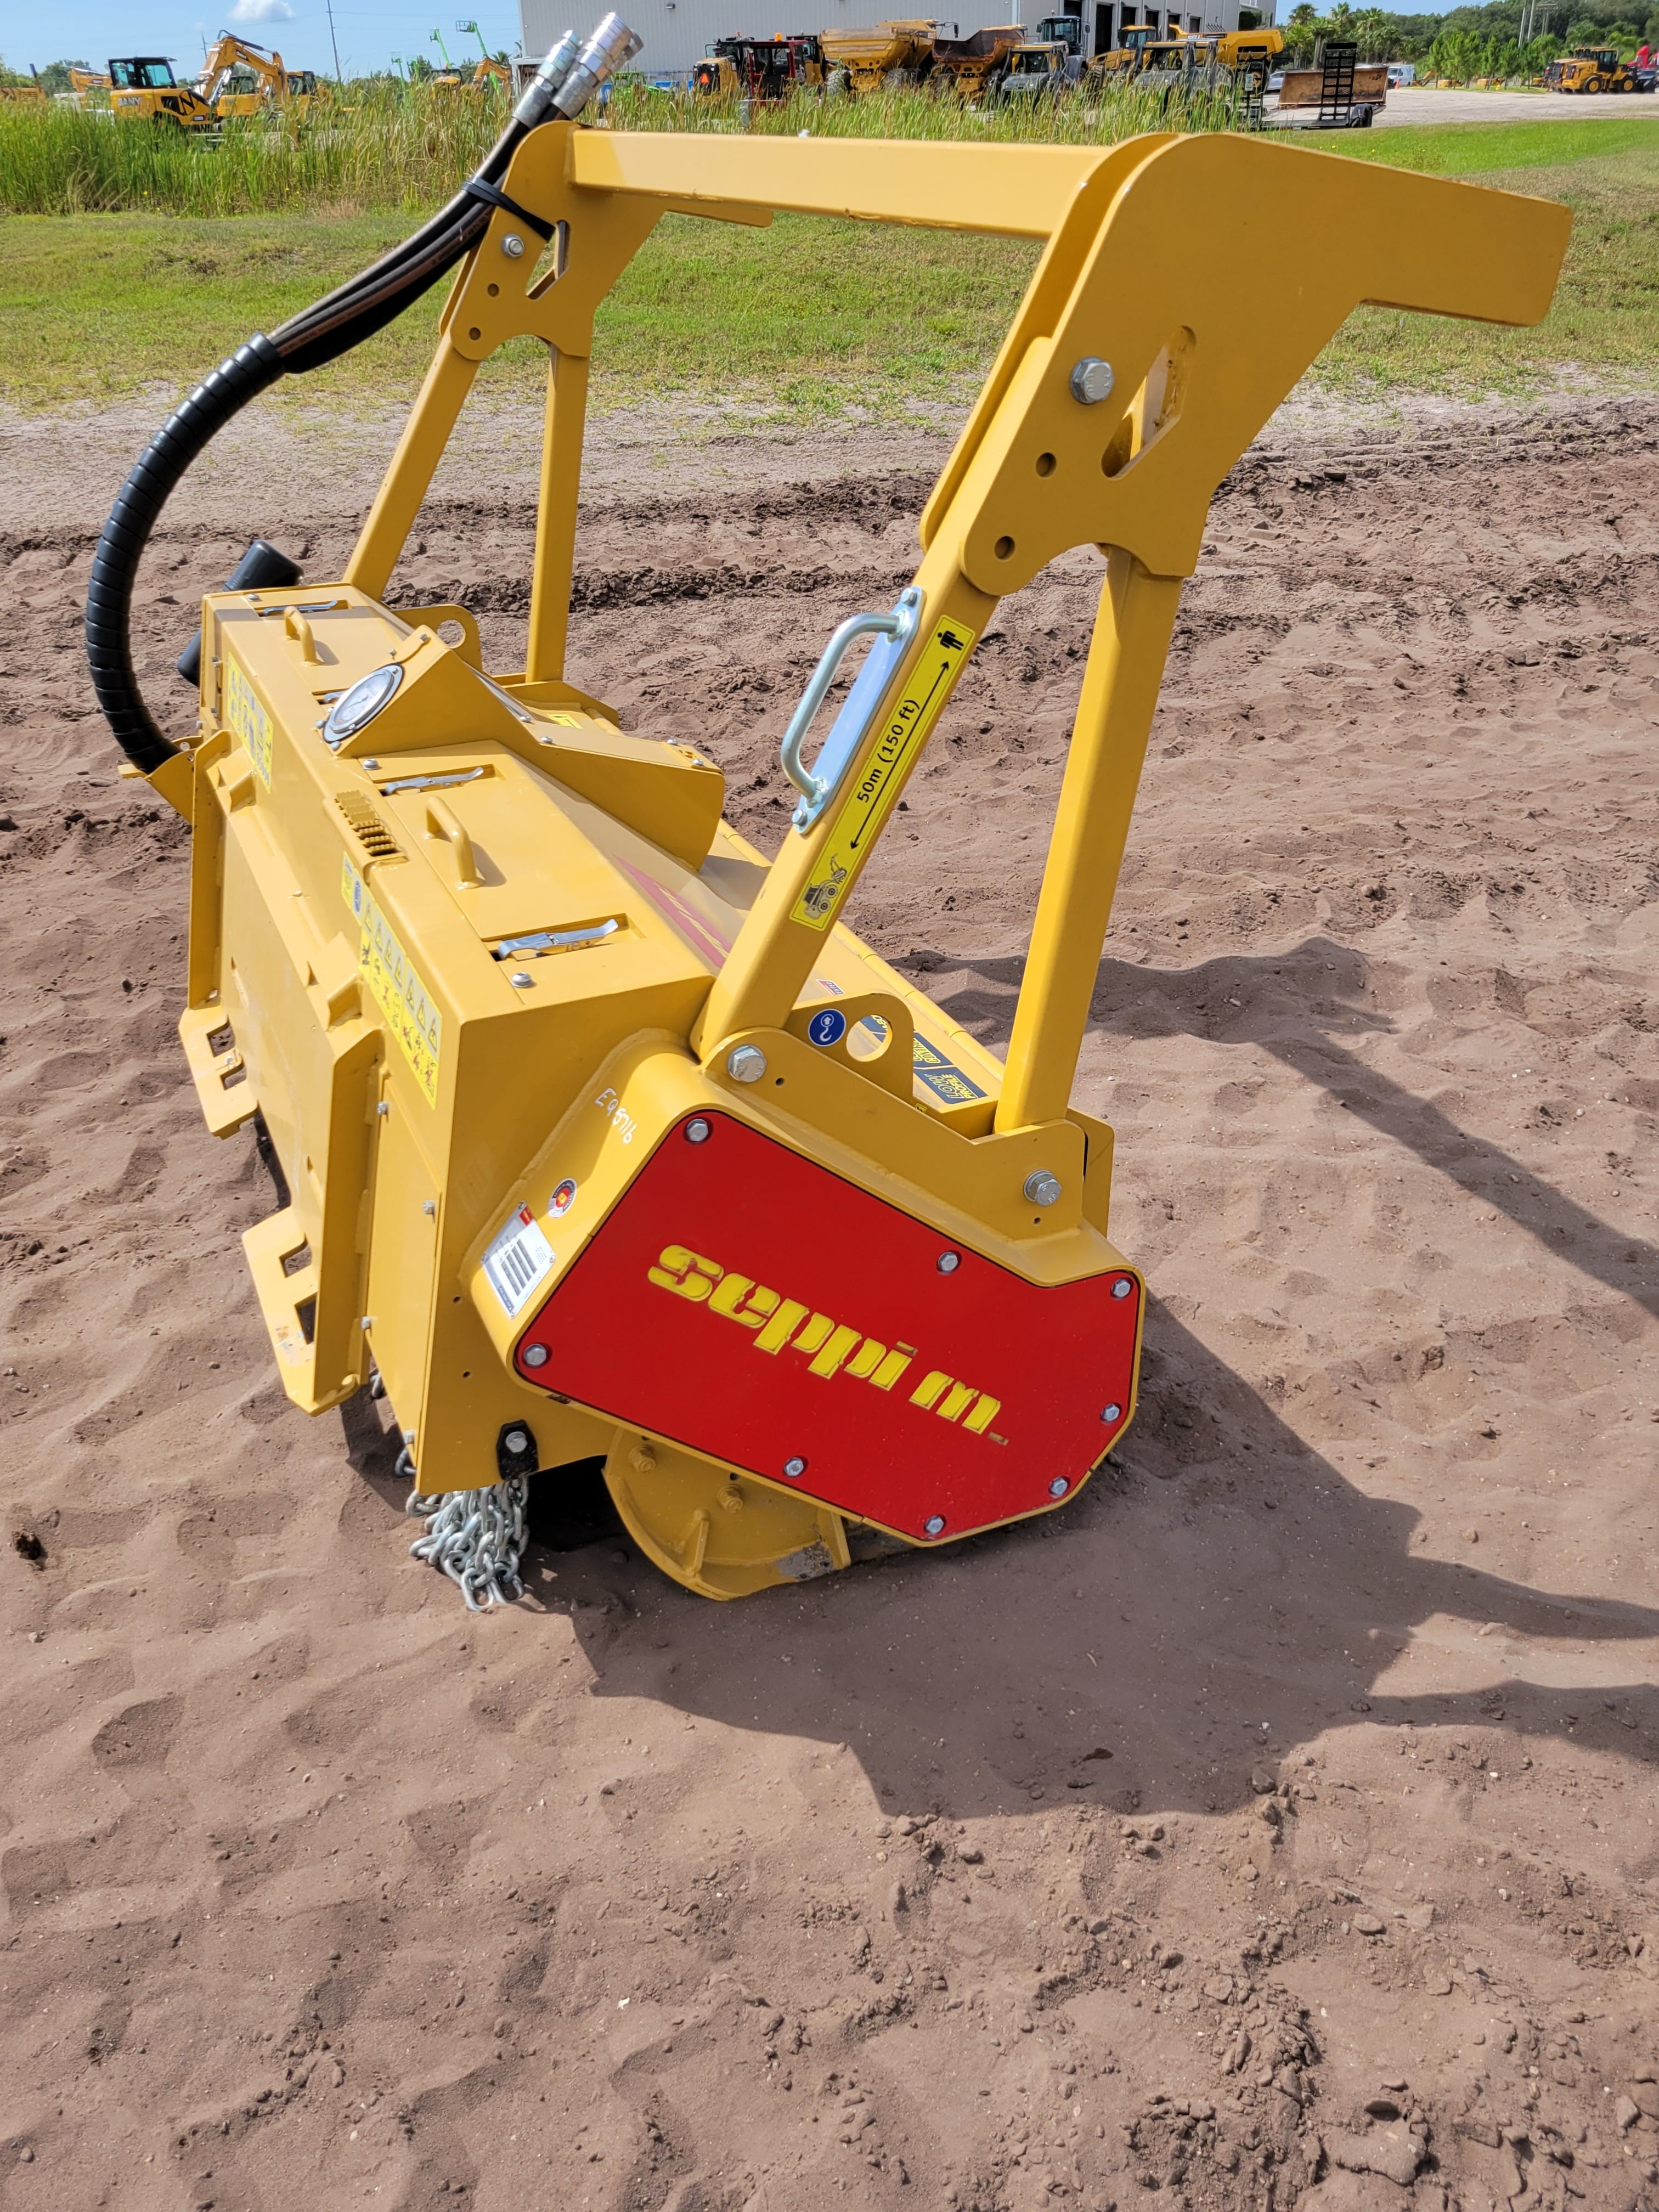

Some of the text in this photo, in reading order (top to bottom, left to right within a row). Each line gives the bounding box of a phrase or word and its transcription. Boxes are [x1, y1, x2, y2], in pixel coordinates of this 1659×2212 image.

[857, 699, 921, 803] 50m (150 ft)
[913, 1037, 941, 1063] CONTRO
[924, 1073, 964, 1099] LOW
[941, 1073, 975, 1099] PROFILE
[647, 1244, 918, 1392] Seppi
